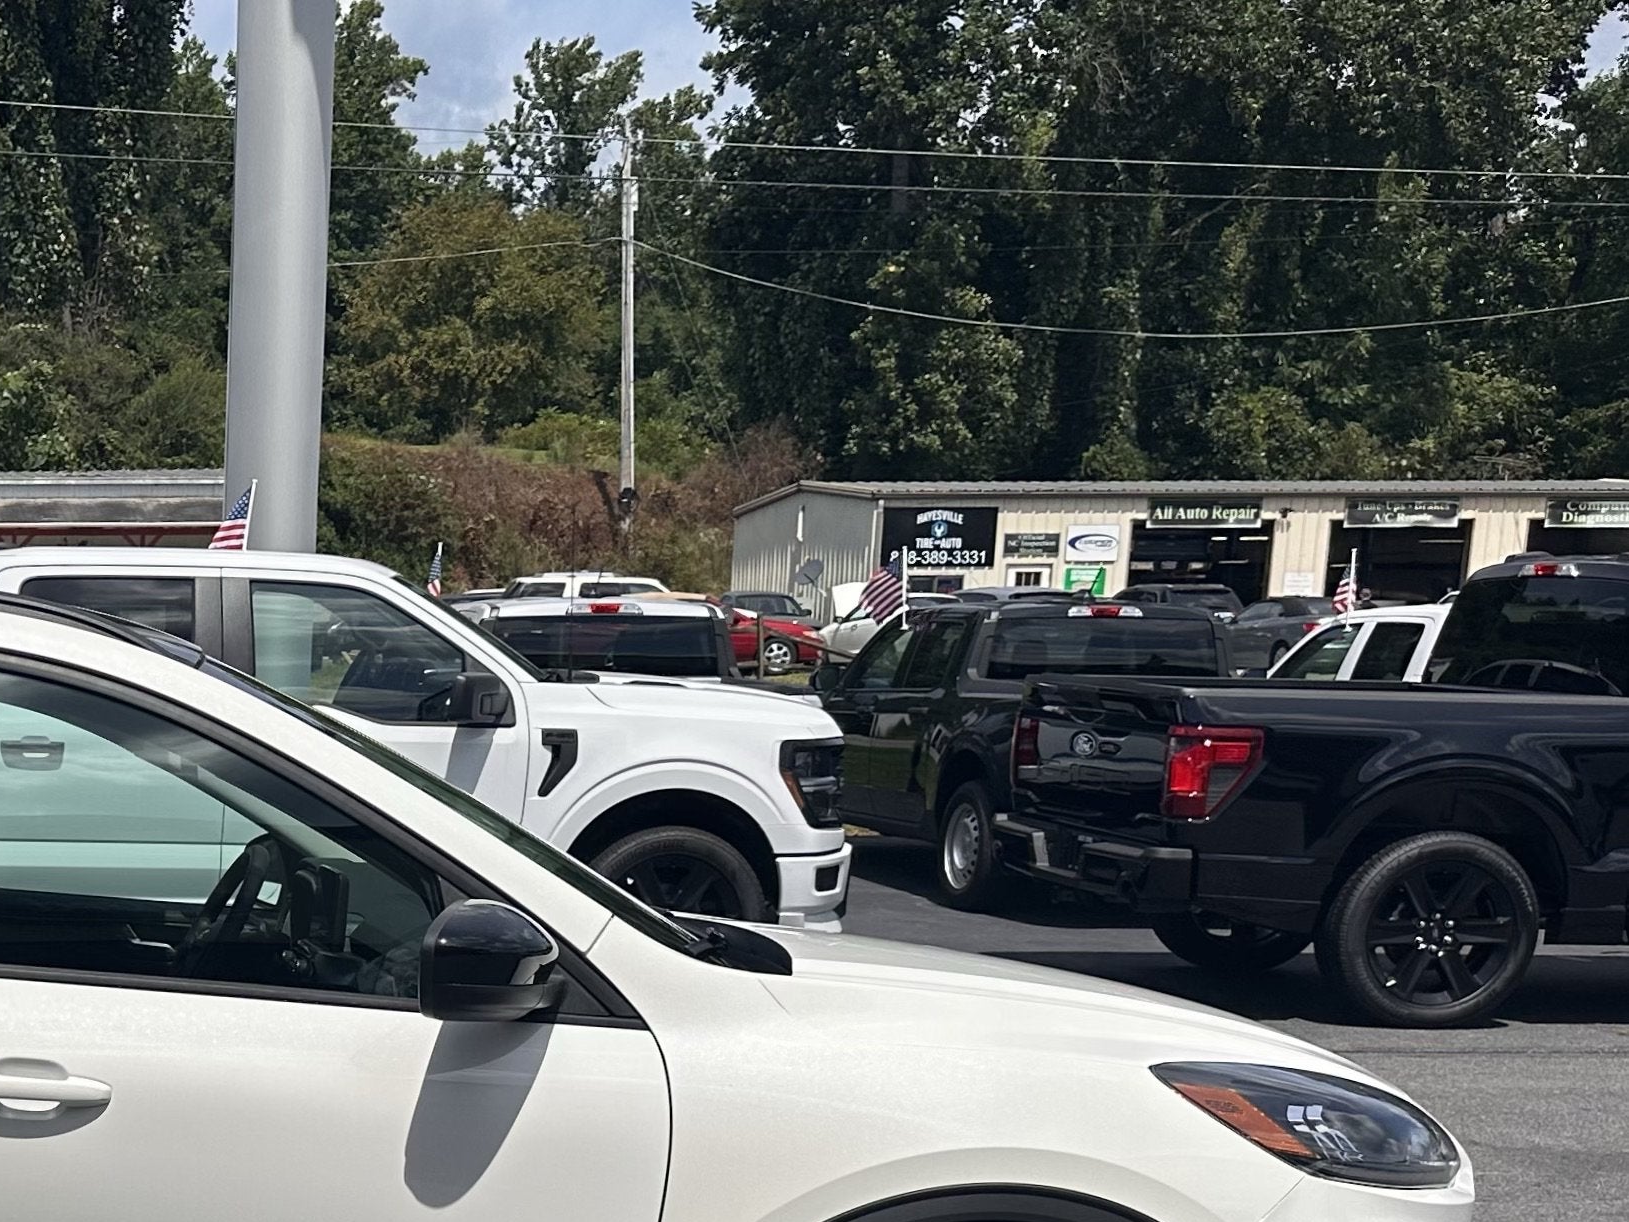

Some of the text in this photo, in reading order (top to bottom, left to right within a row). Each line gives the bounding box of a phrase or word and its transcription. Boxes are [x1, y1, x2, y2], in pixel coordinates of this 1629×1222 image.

[916, 509, 964, 525] HAYESVILLE
[1152, 505, 1258, 523] All Auto Repair
[915, 537, 934, 549] TIRE
[940, 537, 962, 549] AUTO
[890, 550, 986, 564] 88-389-3331
